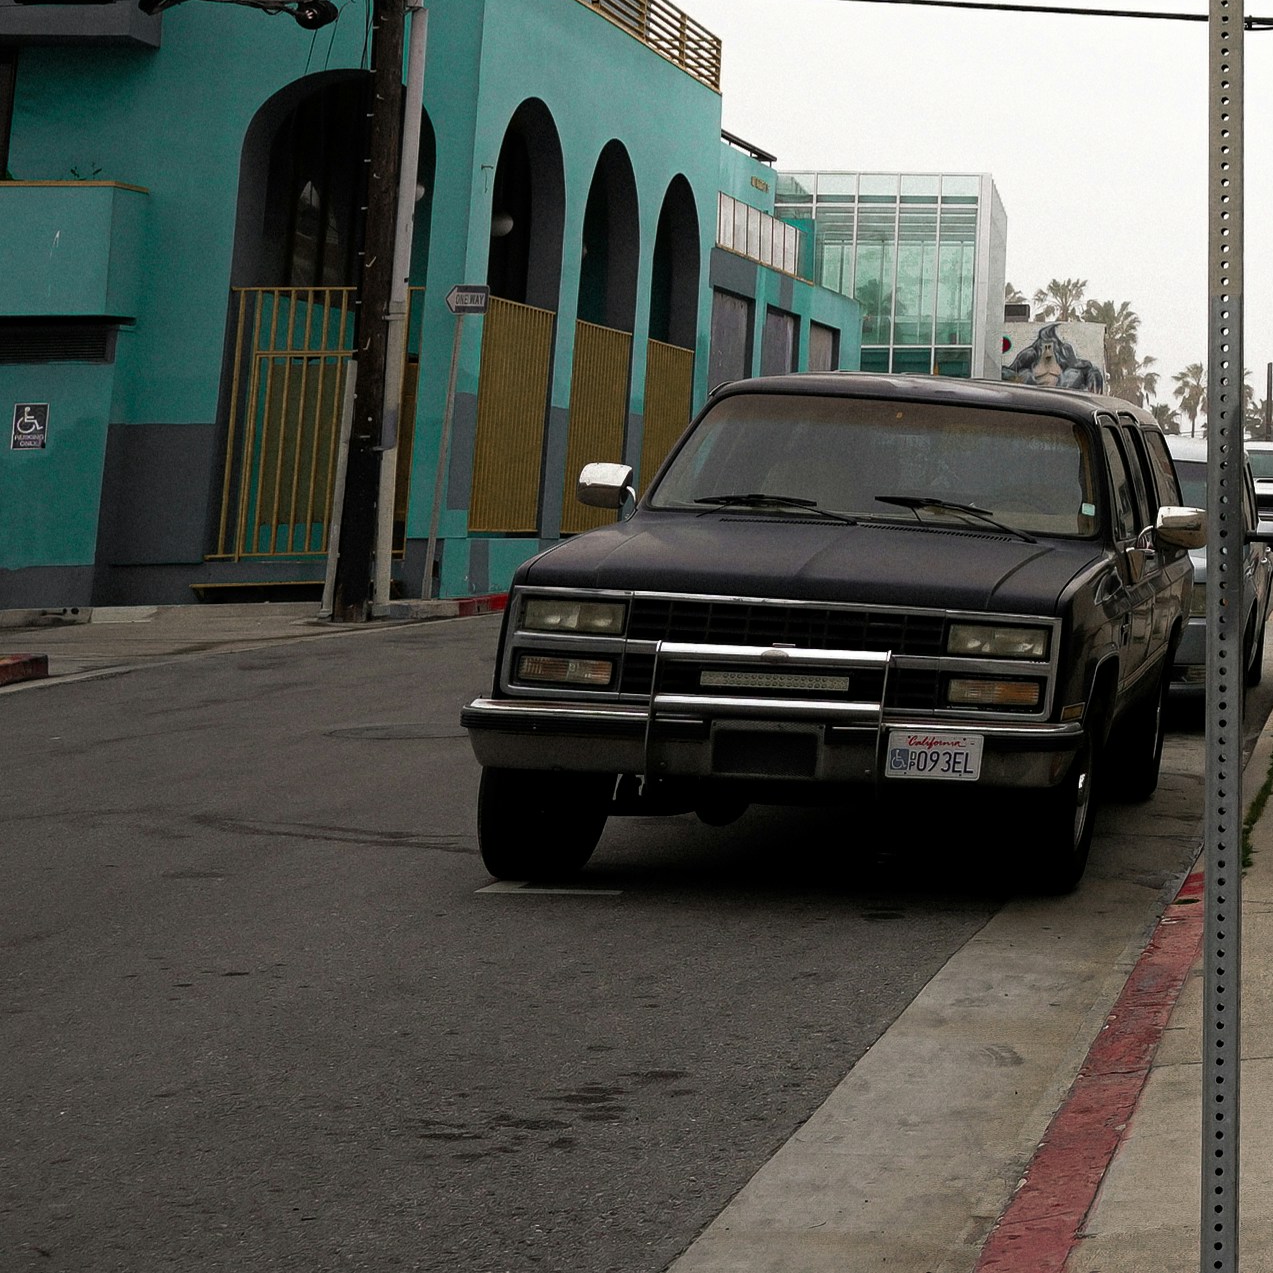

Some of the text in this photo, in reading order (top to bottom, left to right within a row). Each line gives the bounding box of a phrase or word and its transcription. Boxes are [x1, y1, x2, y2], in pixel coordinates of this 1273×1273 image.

[456, 294, 484, 305] ONE WAY
[908, 735, 962, 750] California
[916, 750, 974, 774] 093EL
